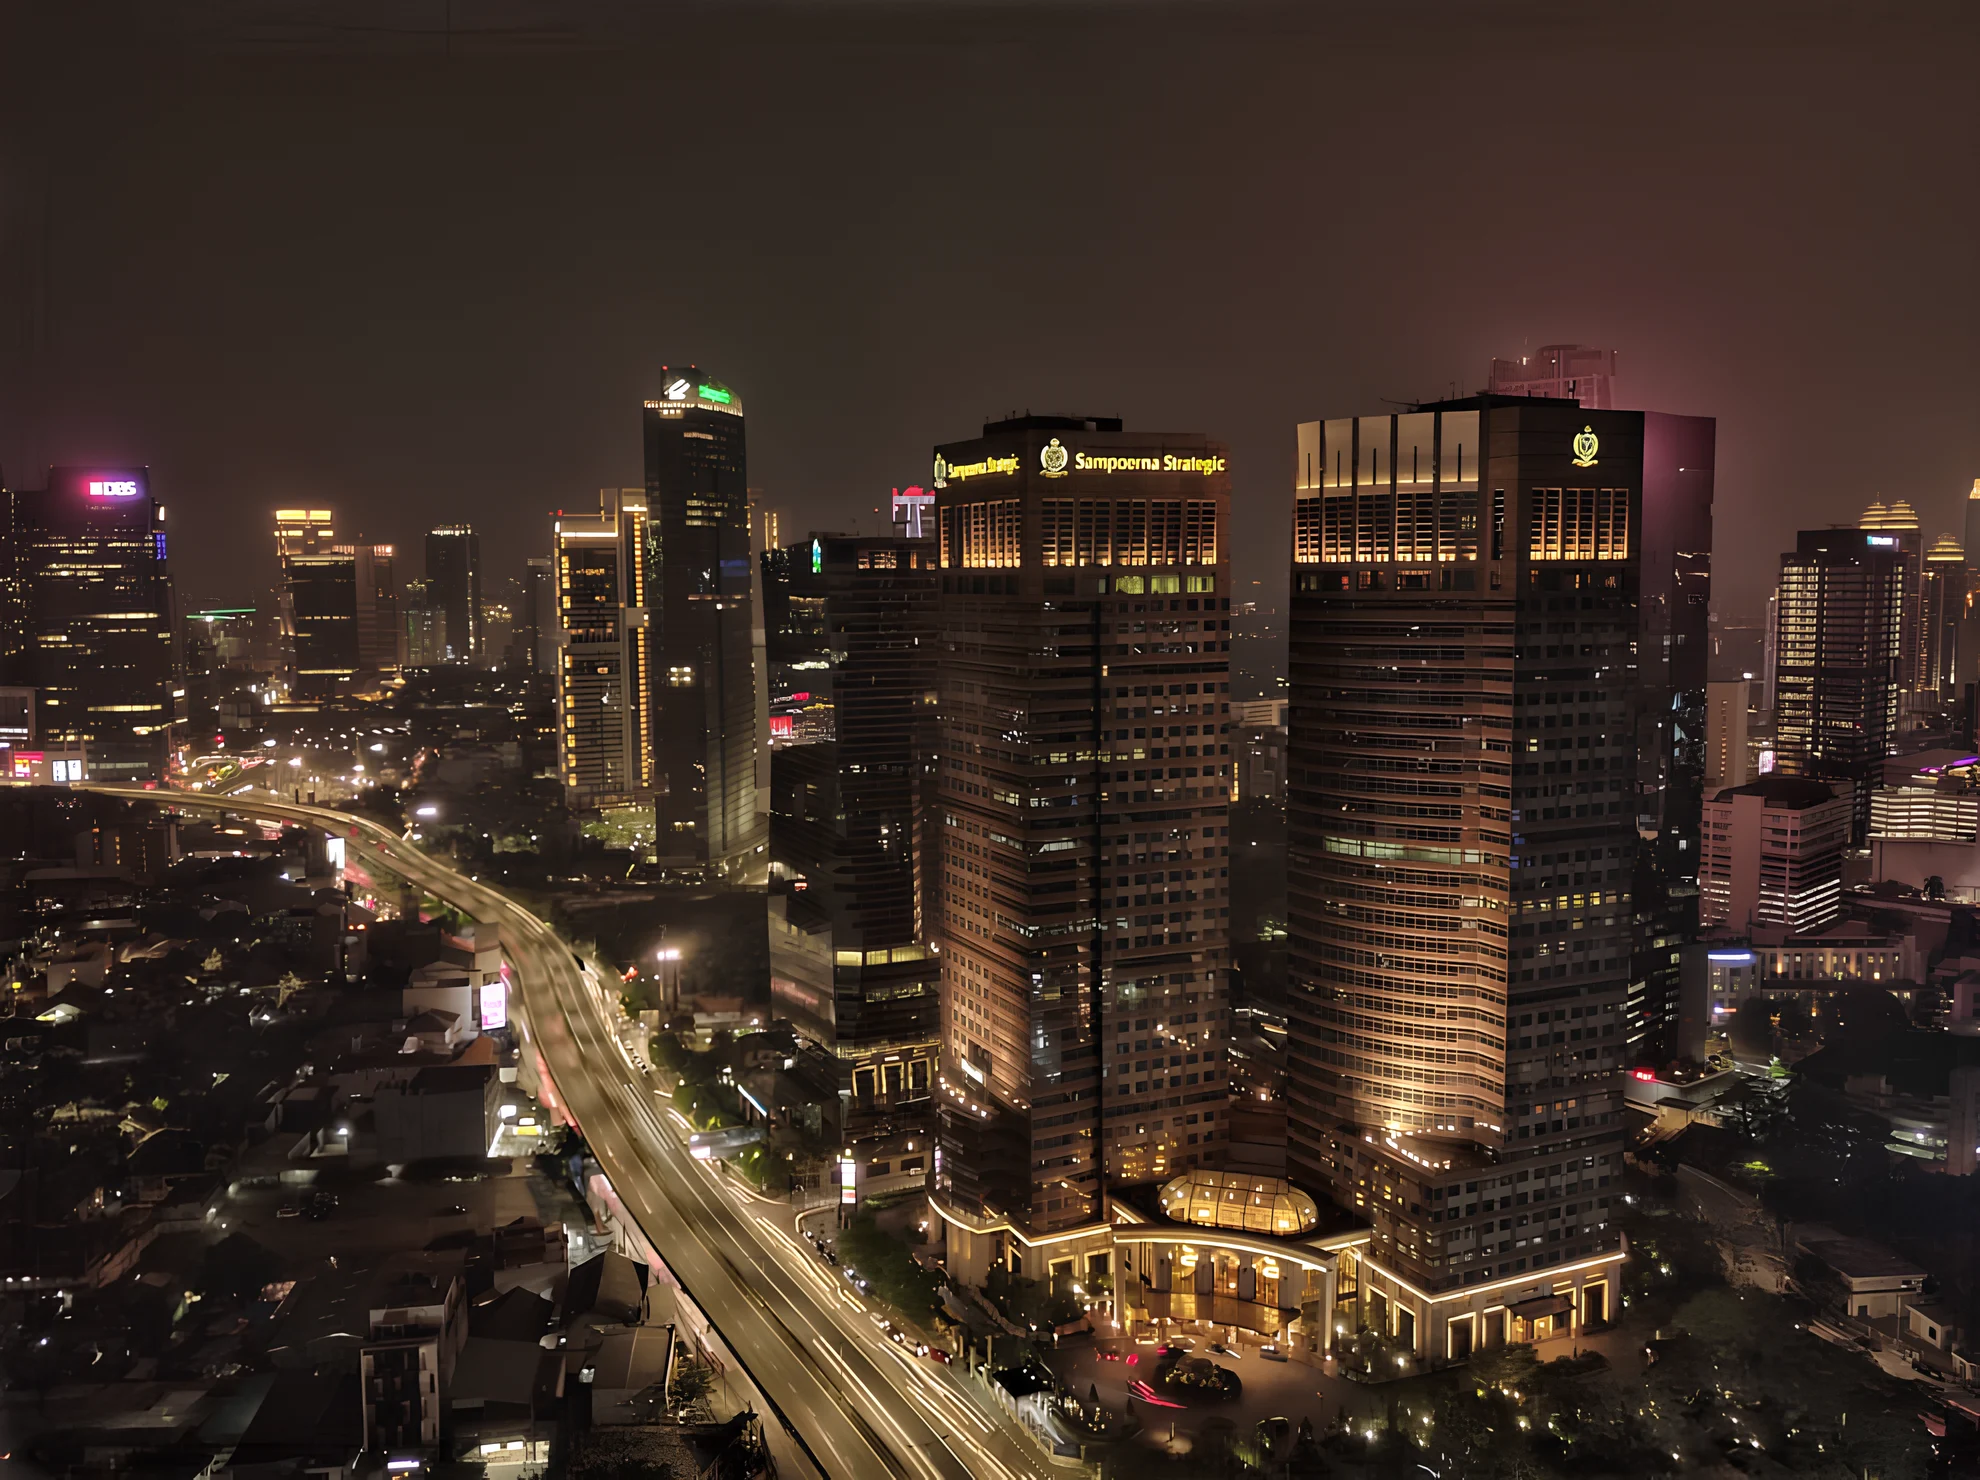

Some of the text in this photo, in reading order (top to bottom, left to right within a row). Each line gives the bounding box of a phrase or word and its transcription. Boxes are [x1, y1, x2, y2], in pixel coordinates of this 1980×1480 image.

[1075, 452, 1226, 476] Sampoerna Strategic
[103, 481, 136, 496] DBS
